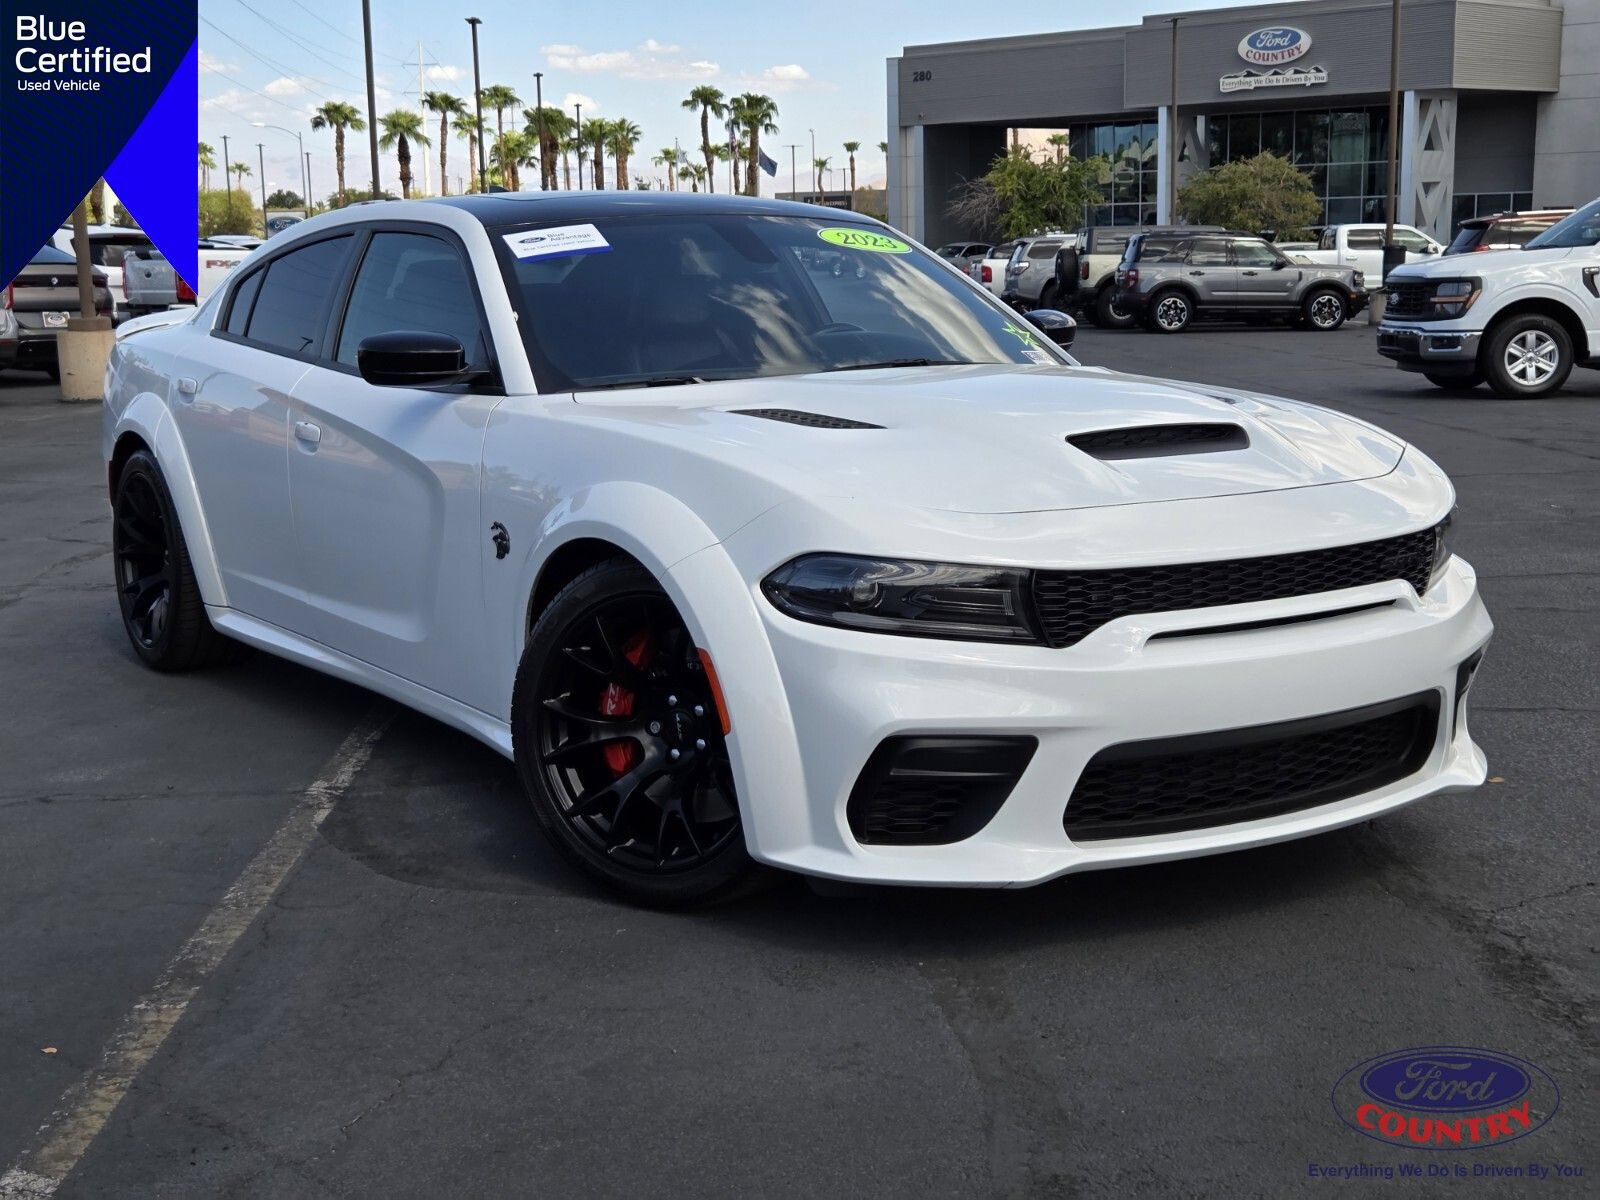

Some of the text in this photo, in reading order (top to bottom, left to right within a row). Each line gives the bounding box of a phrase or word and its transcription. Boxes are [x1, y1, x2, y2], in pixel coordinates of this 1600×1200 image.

[1256, 30, 1291, 47] Ford
[1245, 44, 1303, 62] COUNTRY
[912, 71, 932, 82] 280
[1221, 78, 1252, 87] Everything
[1254, 77, 1264, 85] We
[1265, 76, 1274, 84] Do
[1282, 75, 1303, 83] Driven
[1304, 75, 1311, 83] By
[836, 232, 898, 249] 2023
